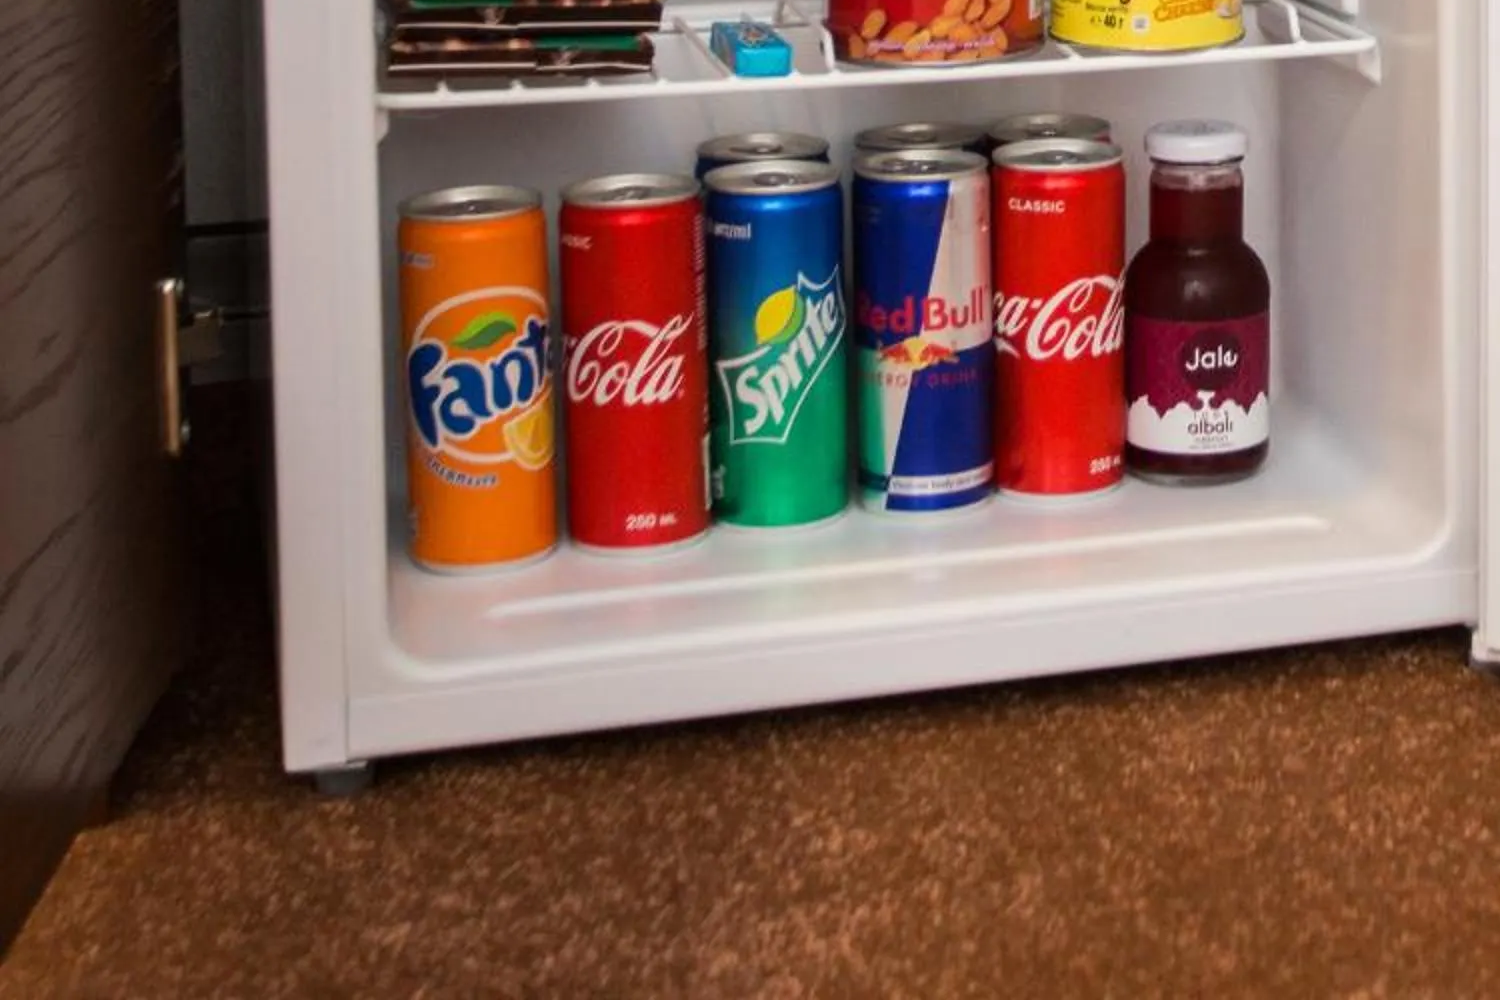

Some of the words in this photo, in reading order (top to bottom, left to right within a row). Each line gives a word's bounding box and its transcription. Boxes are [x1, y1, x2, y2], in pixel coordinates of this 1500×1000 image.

[1008, 197, 1065, 213] CLASSIC
[858, 295, 914, 334] Red
[922, 287, 985, 332] Bull
[407, 318, 552, 447] Fant
[736, 290, 838, 436] Sprite
